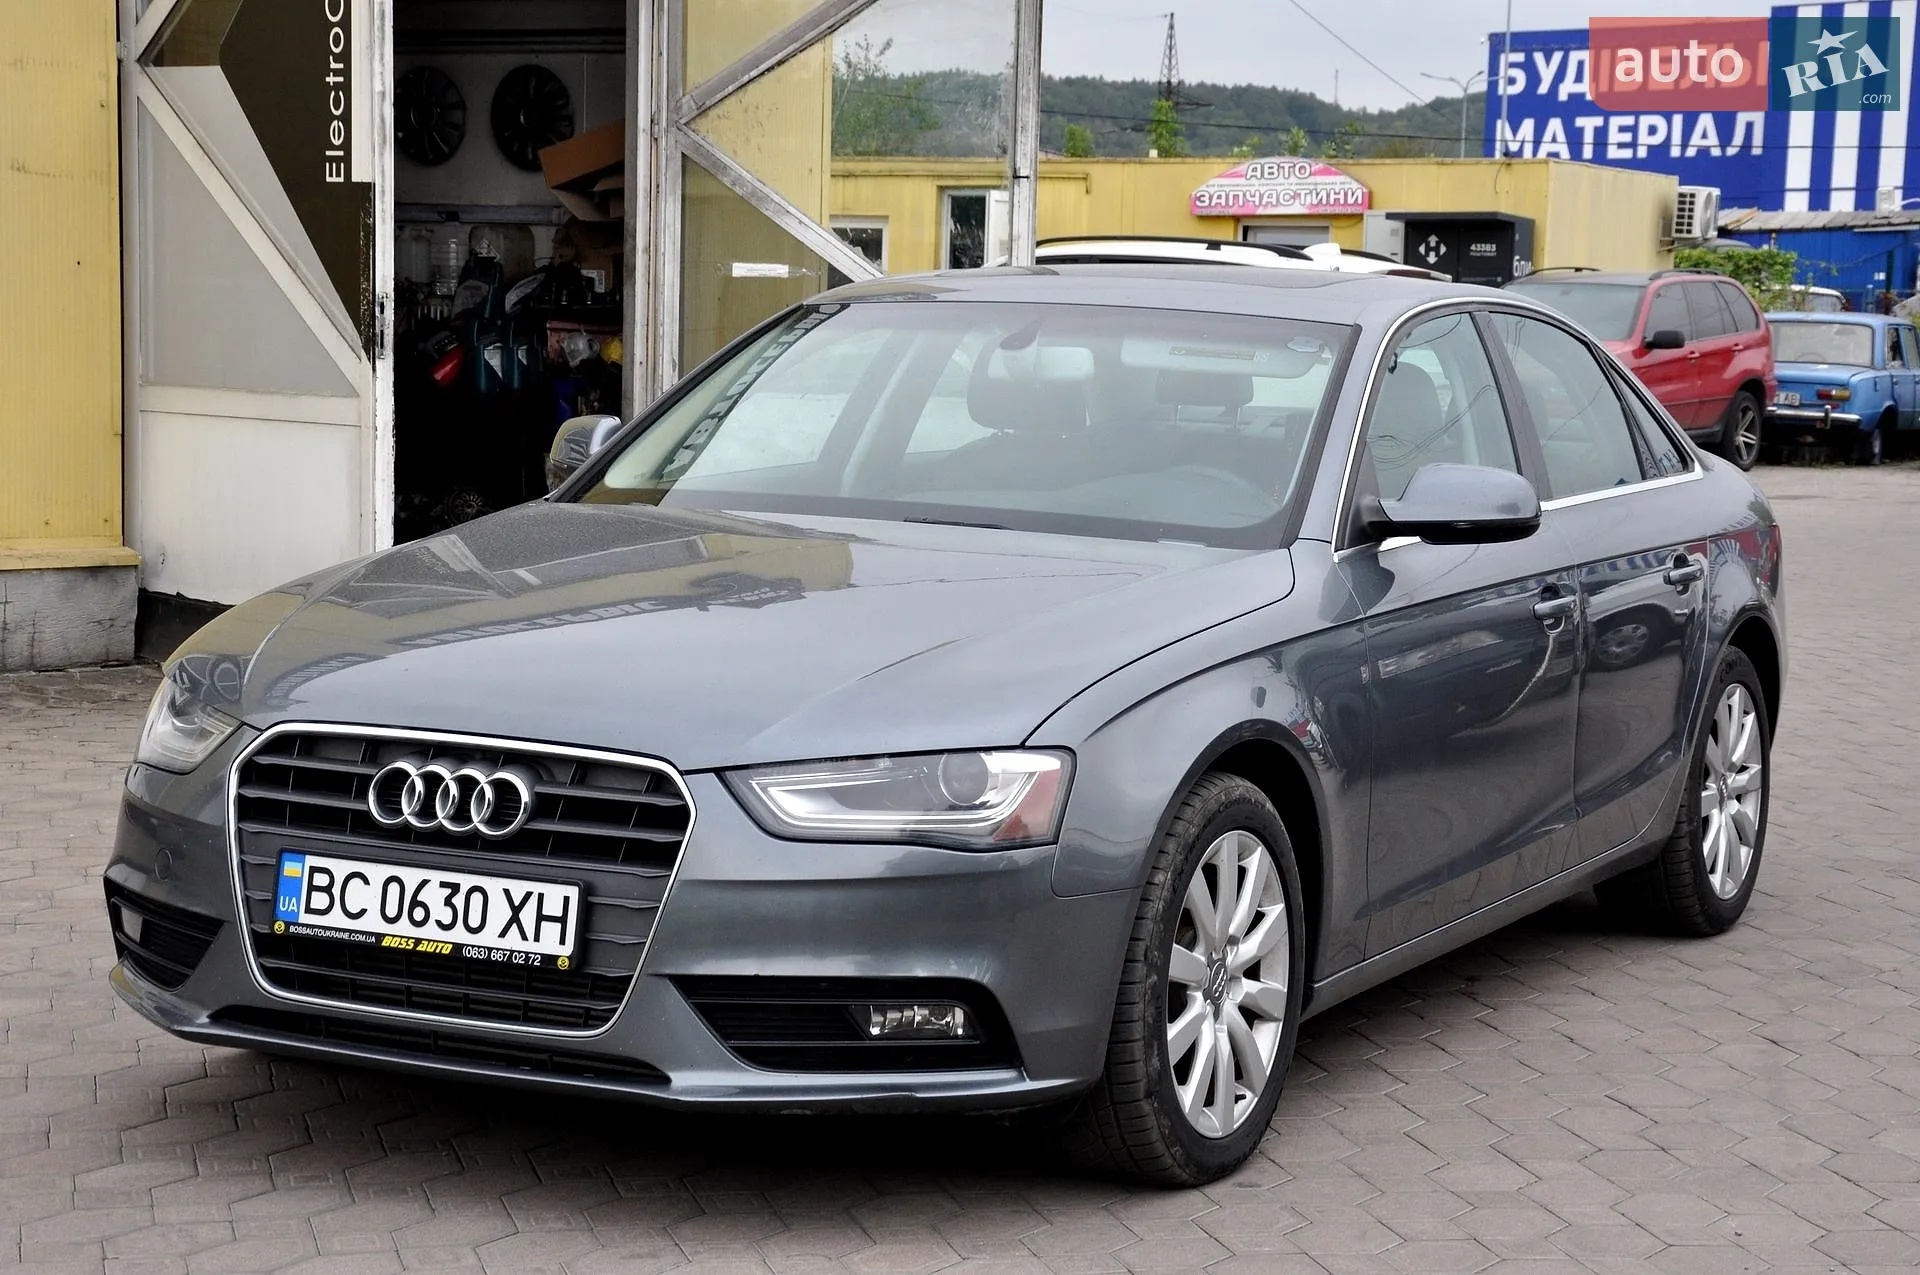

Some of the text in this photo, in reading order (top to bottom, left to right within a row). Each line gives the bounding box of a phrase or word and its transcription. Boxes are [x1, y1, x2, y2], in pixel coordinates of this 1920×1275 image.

[1494, 111, 1766, 161] МАТЕРІАЛ
[1246, 162, 1312, 180] АВТО
[1195, 187, 1364, 207] ЗАПЧАСТИНИ
[280, 895, 298, 912] UA
[304, 865, 571, 946] BC 0630 XH
[289, 925, 542, 966] BOSSAUTOUKRAINE.COM.UA BOSS AUTO (063) 667 02 72
